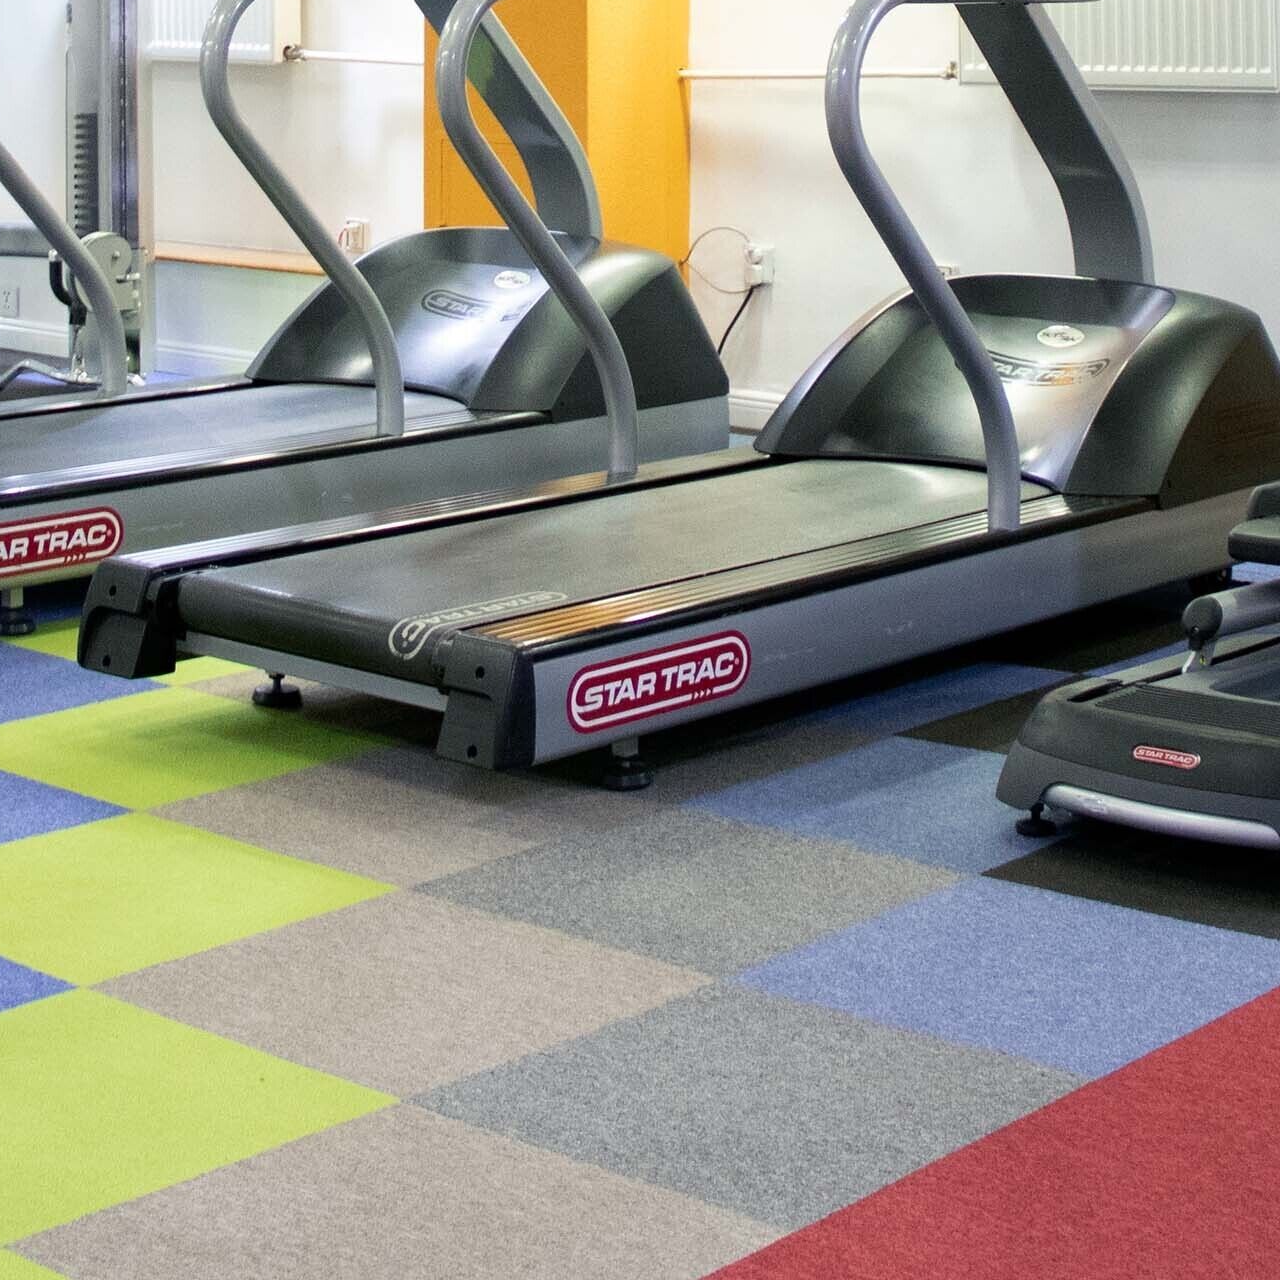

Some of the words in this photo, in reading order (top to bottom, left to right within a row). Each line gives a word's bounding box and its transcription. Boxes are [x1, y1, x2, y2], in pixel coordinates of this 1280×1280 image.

[33, 523, 109, 555] TRAC
[582, 671, 658, 714] STAR
[660, 650, 735, 693] TRAC
[1136, 748, 1164, 760] STAR
[1164, 753, 1194, 765] TRAC
